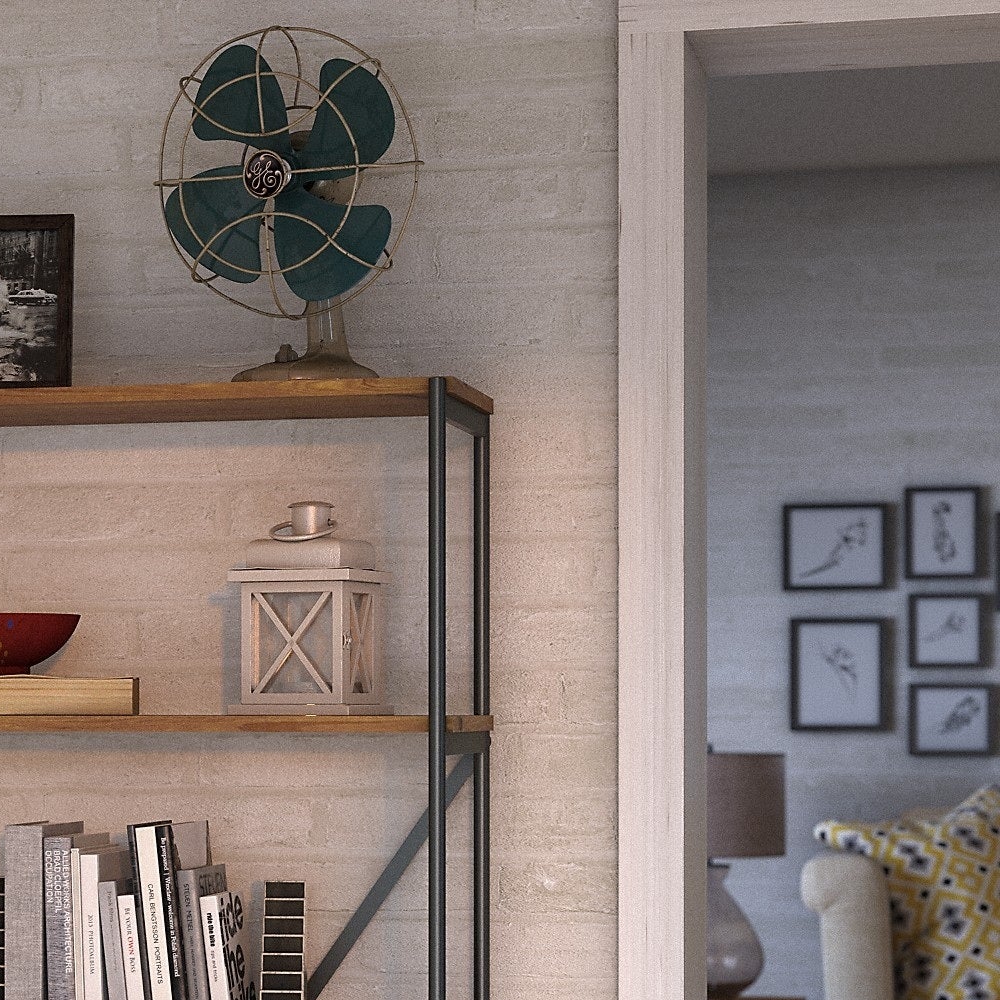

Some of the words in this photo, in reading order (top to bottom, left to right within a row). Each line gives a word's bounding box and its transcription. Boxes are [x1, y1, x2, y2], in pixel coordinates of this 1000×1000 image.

[45, 850, 53, 903] OCCUPATION
[62, 850, 70, 877] ALLIED
[63, 880, 71, 909] WORKS
[147, 883, 155, 901] CARL
[149, 902, 159, 943] BENGTSSON
[64, 911, 73, 973] ARCHITECTURE
[154, 946, 163, 984] PORTRAITS
